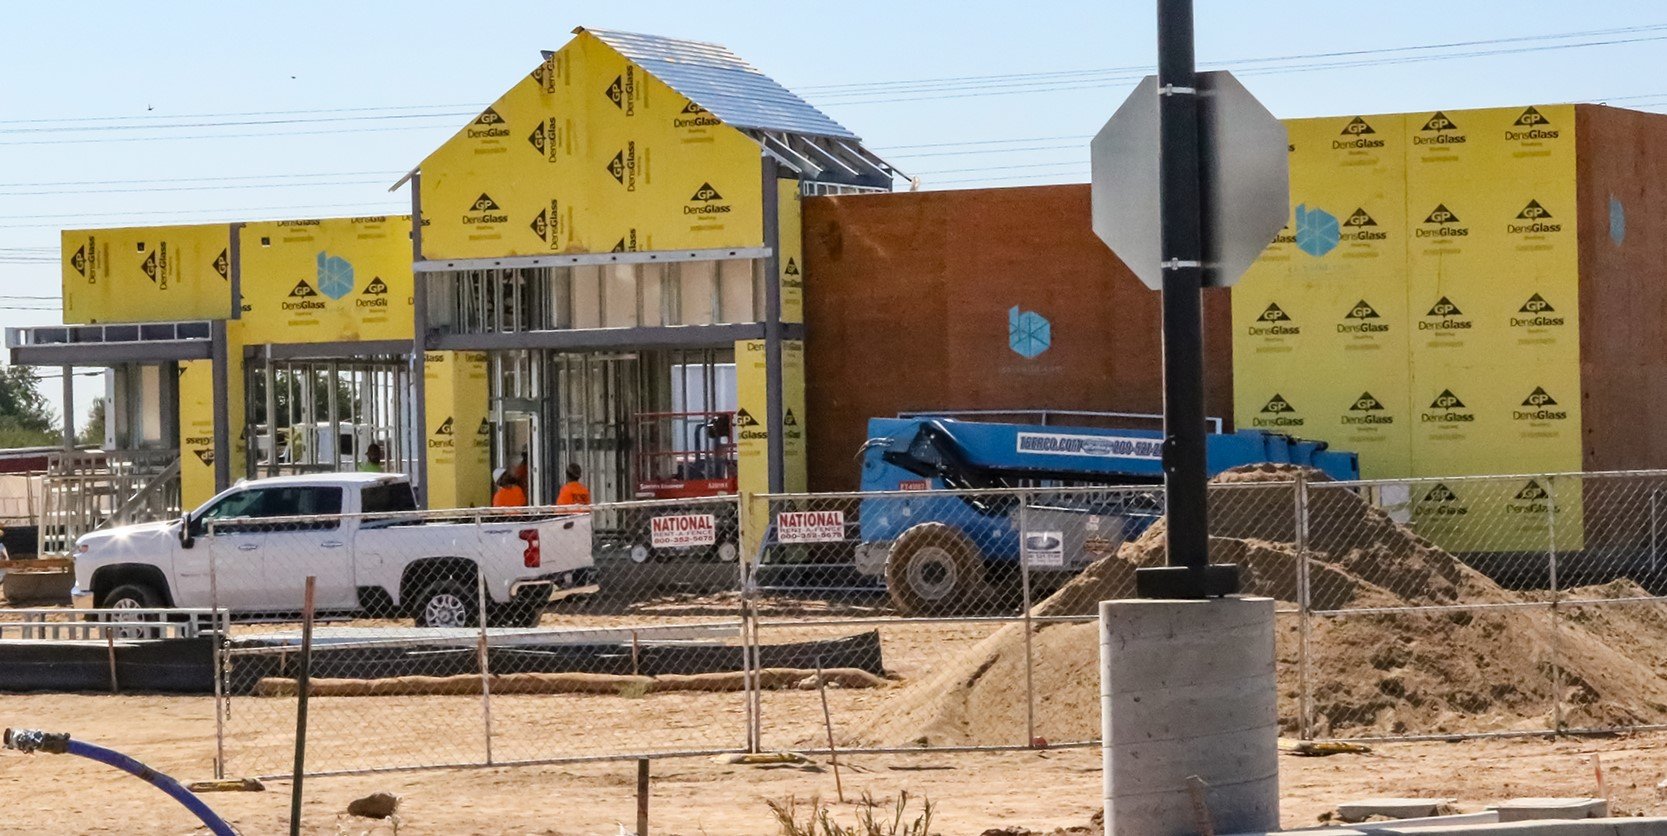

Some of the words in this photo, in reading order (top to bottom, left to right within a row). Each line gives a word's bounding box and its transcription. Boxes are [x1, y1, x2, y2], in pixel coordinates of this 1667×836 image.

[613, 83, 621, 101] GP
[482, 113, 498, 123] GP
[1521, 114, 1541, 124] GP
[1347, 123, 1368, 133] GP
[1429, 119, 1448, 129] GP
[537, 130, 544, 149] GP
[1413, 134, 1466, 145] DensGlass
[1505, 129, 1559, 141] DensGlass
[1332, 138, 1384, 150] DensGlass
[614, 158, 623, 177] GP
[697, 190, 715, 199] GP
[476, 200, 492, 209] GP
[684, 204, 731, 214] DensGlass
[1432, 211, 1451, 222] GP
[1524, 207, 1543, 218] GP
[462, 215, 508, 224] DensGlass
[1351, 215, 1370, 225] GP
[538, 217, 546, 236] GP
[1507, 223, 1561, 233] DensGlass
[1416, 227, 1469, 238] DensGlass
[76, 253, 86, 270] GP
[147, 258, 156, 276] GP
[218, 256, 228, 274] GP
[294, 285, 310, 295] GP
[368, 282, 385, 292] GP
[282, 300, 326, 310] DensGlass
[1434, 304, 1454, 315] GP
[1526, 301, 1546, 312] GP
[1264, 310, 1283, 320] GP
[1352, 307, 1372, 317] GP
[1418, 319, 1472, 330] DensGlass
[1510, 316, 1564, 327] DensGlass
[1248, 326, 1300, 336] DensGlass
[1336, 322, 1389, 333] DensGlass
[1357, 399, 1376, 409] GP
[1437, 397, 1456, 407] GP
[1529, 394, 1548, 405] GP
[1268, 401, 1287, 412] GP
[1341, 414, 1393, 425] DensGlass
[1421, 412, 1475, 423] DensGlass
[1513, 410, 1567, 420] DensGlass
[1252, 416, 1304, 427] DensGlass
[653, 516, 712, 532] NATIONAL
[780, 513, 842, 527] NATIONAL
